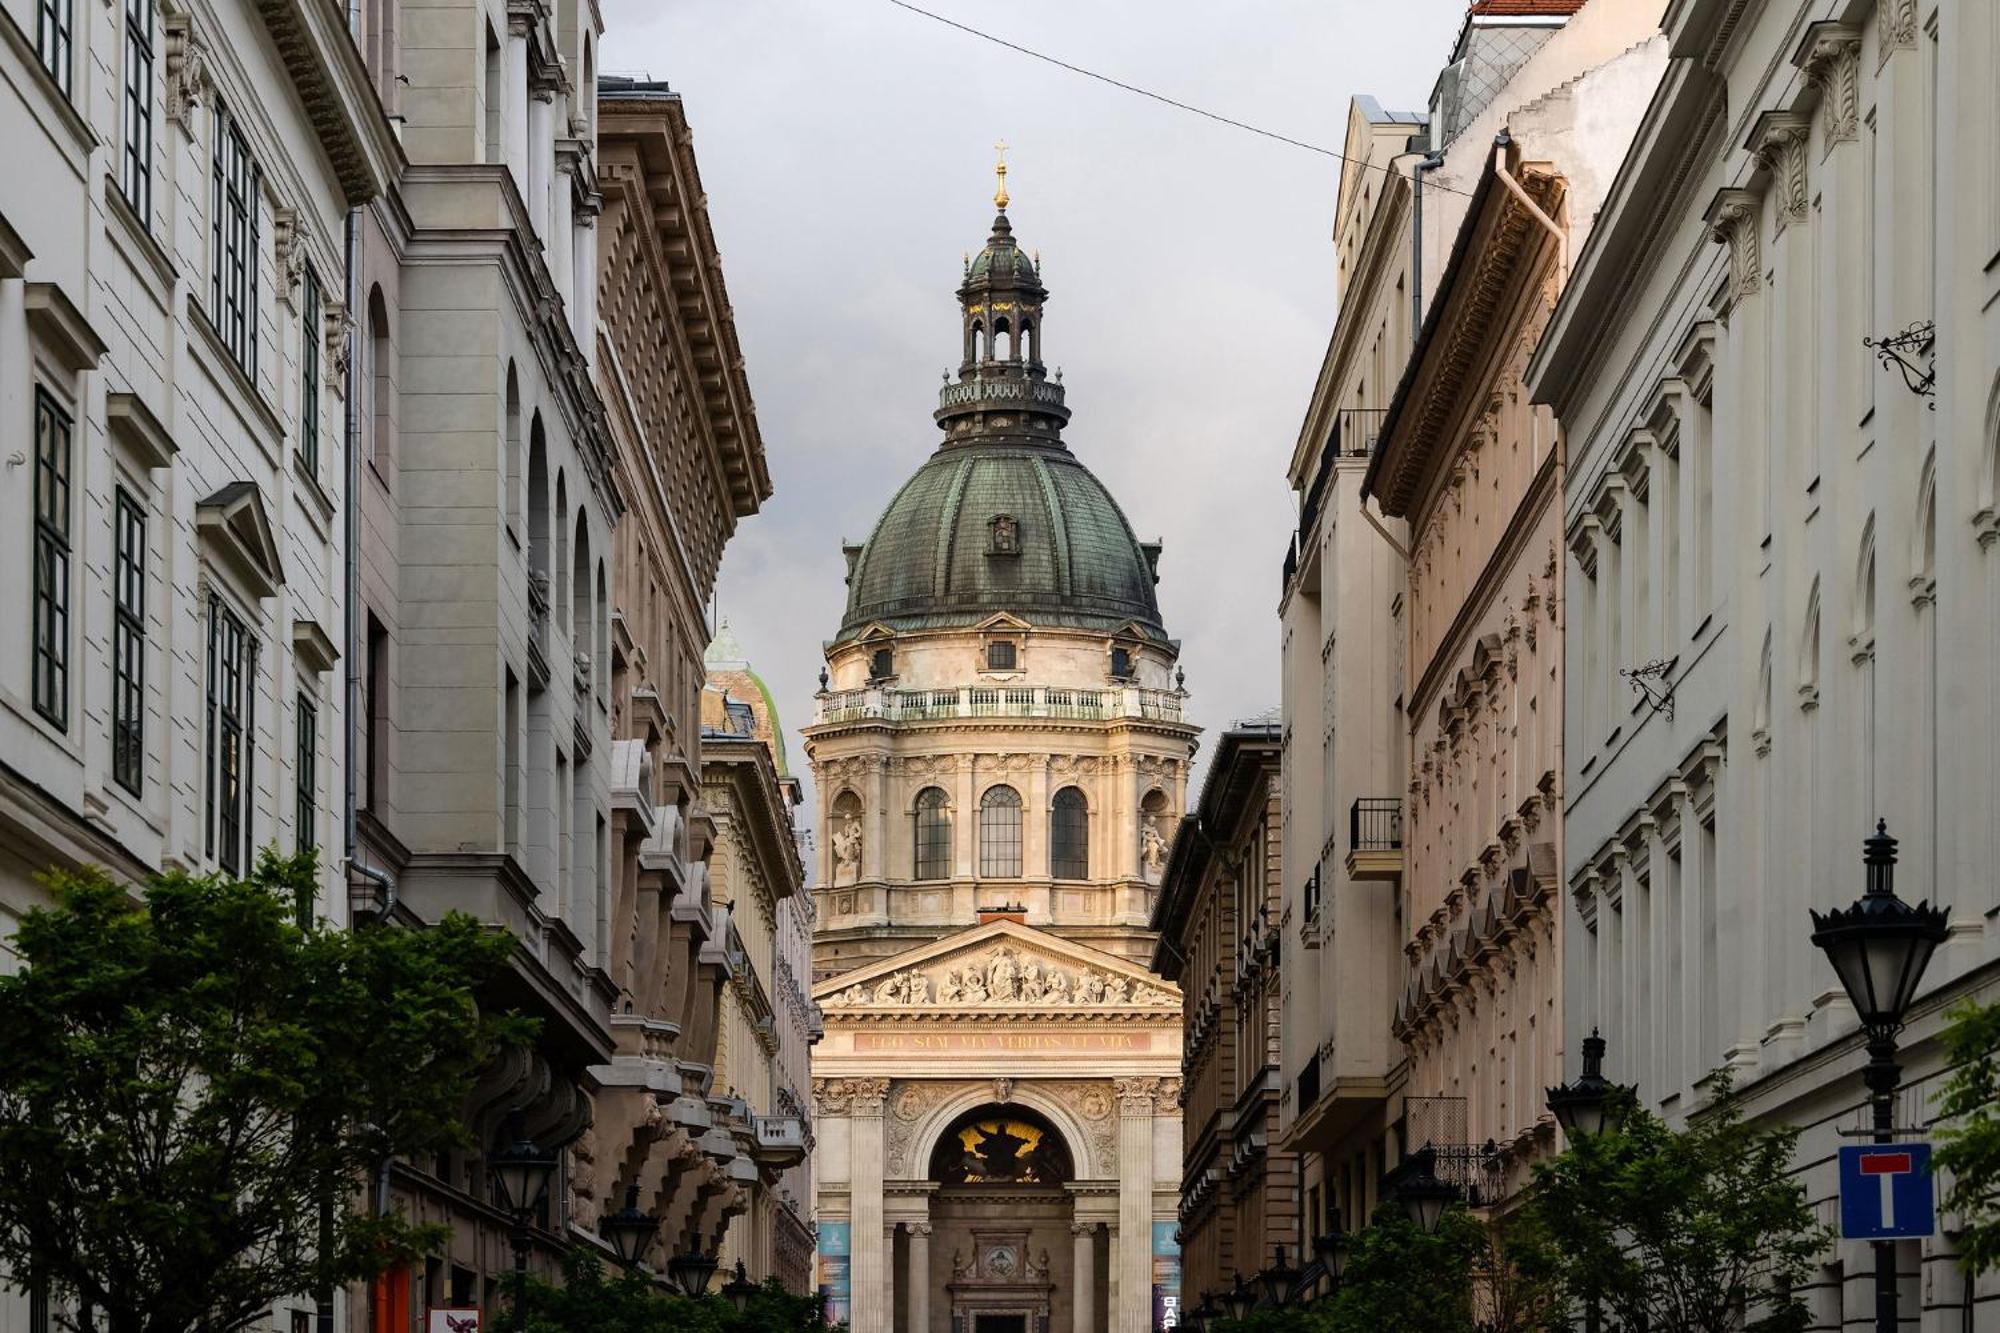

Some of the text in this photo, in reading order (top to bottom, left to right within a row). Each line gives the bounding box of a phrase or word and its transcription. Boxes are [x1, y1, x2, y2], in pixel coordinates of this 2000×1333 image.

[870, 1036, 1135, 1049] EGO SUM VIA VERITAS ET VITA
